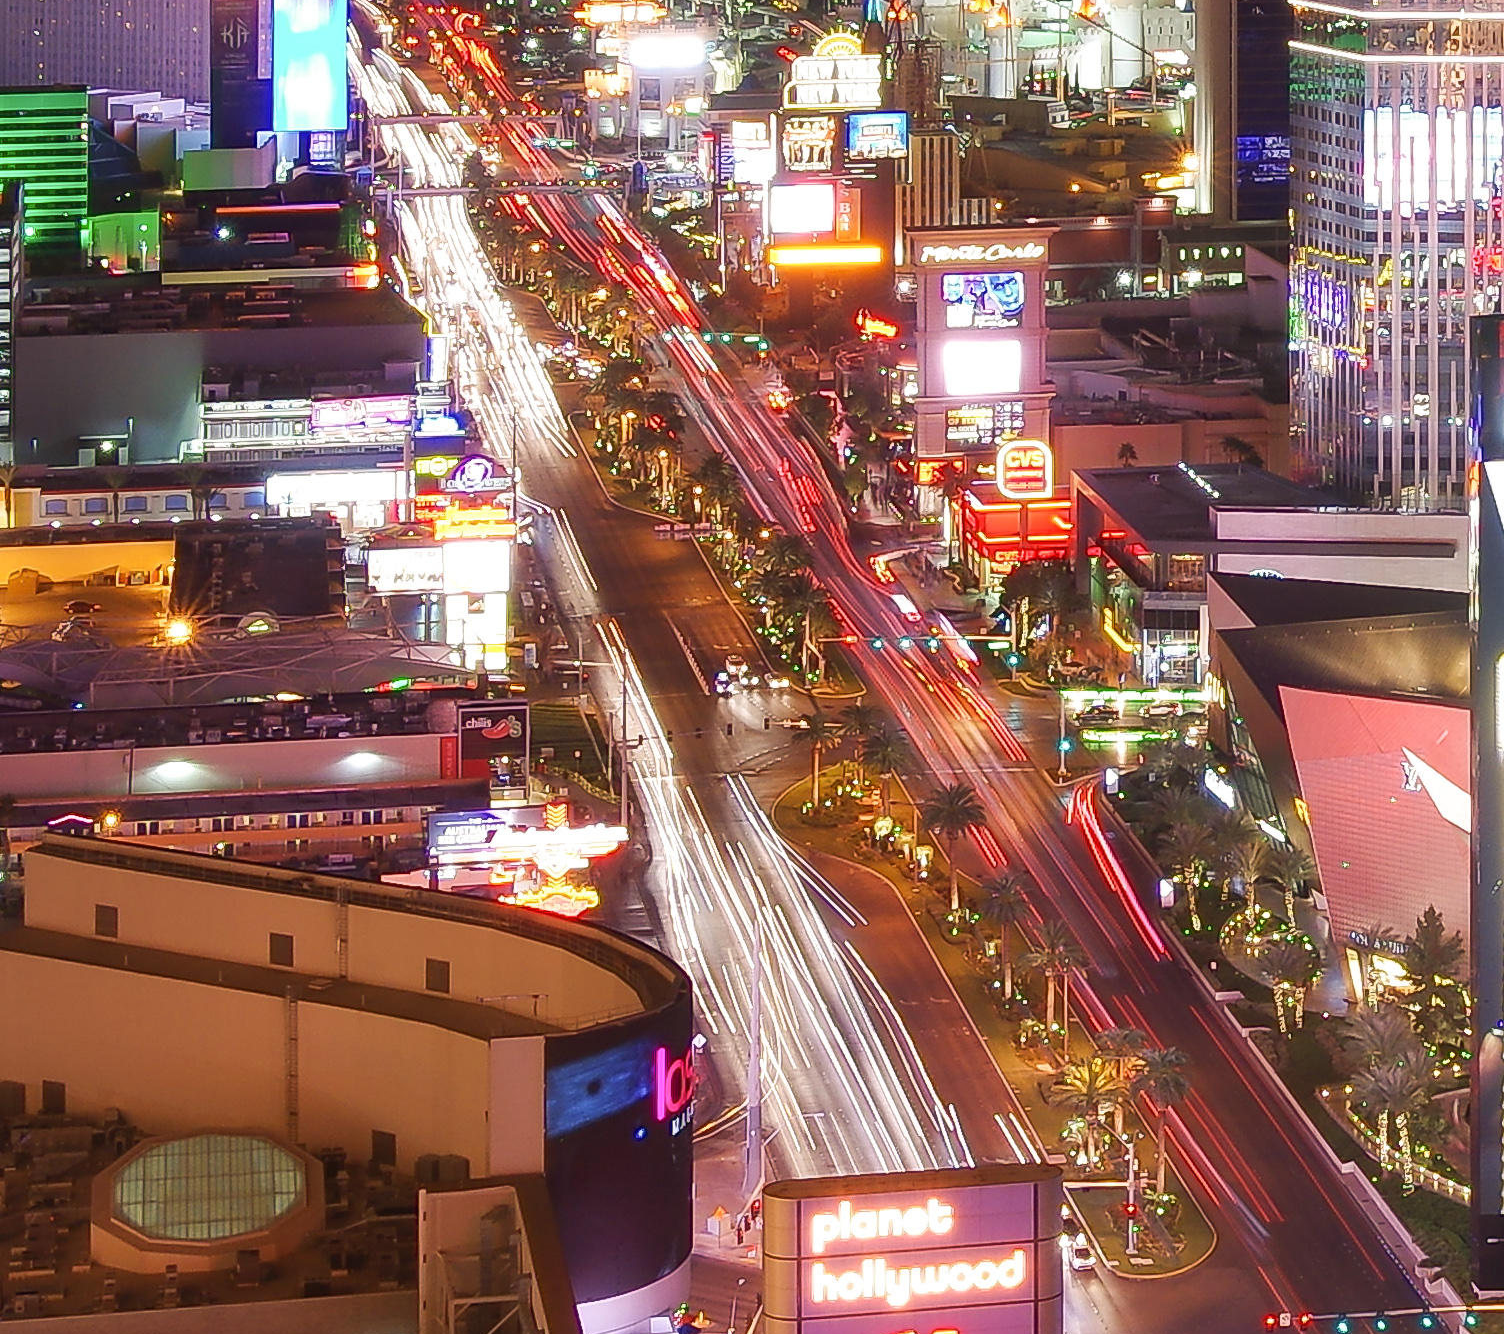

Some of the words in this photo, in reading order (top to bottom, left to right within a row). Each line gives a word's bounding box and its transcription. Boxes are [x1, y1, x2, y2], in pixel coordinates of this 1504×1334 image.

[1005, 451, 1045, 467] CVS
[811, 1198, 954, 1253] planet
[811, 1248, 1026, 1308] hollywood
